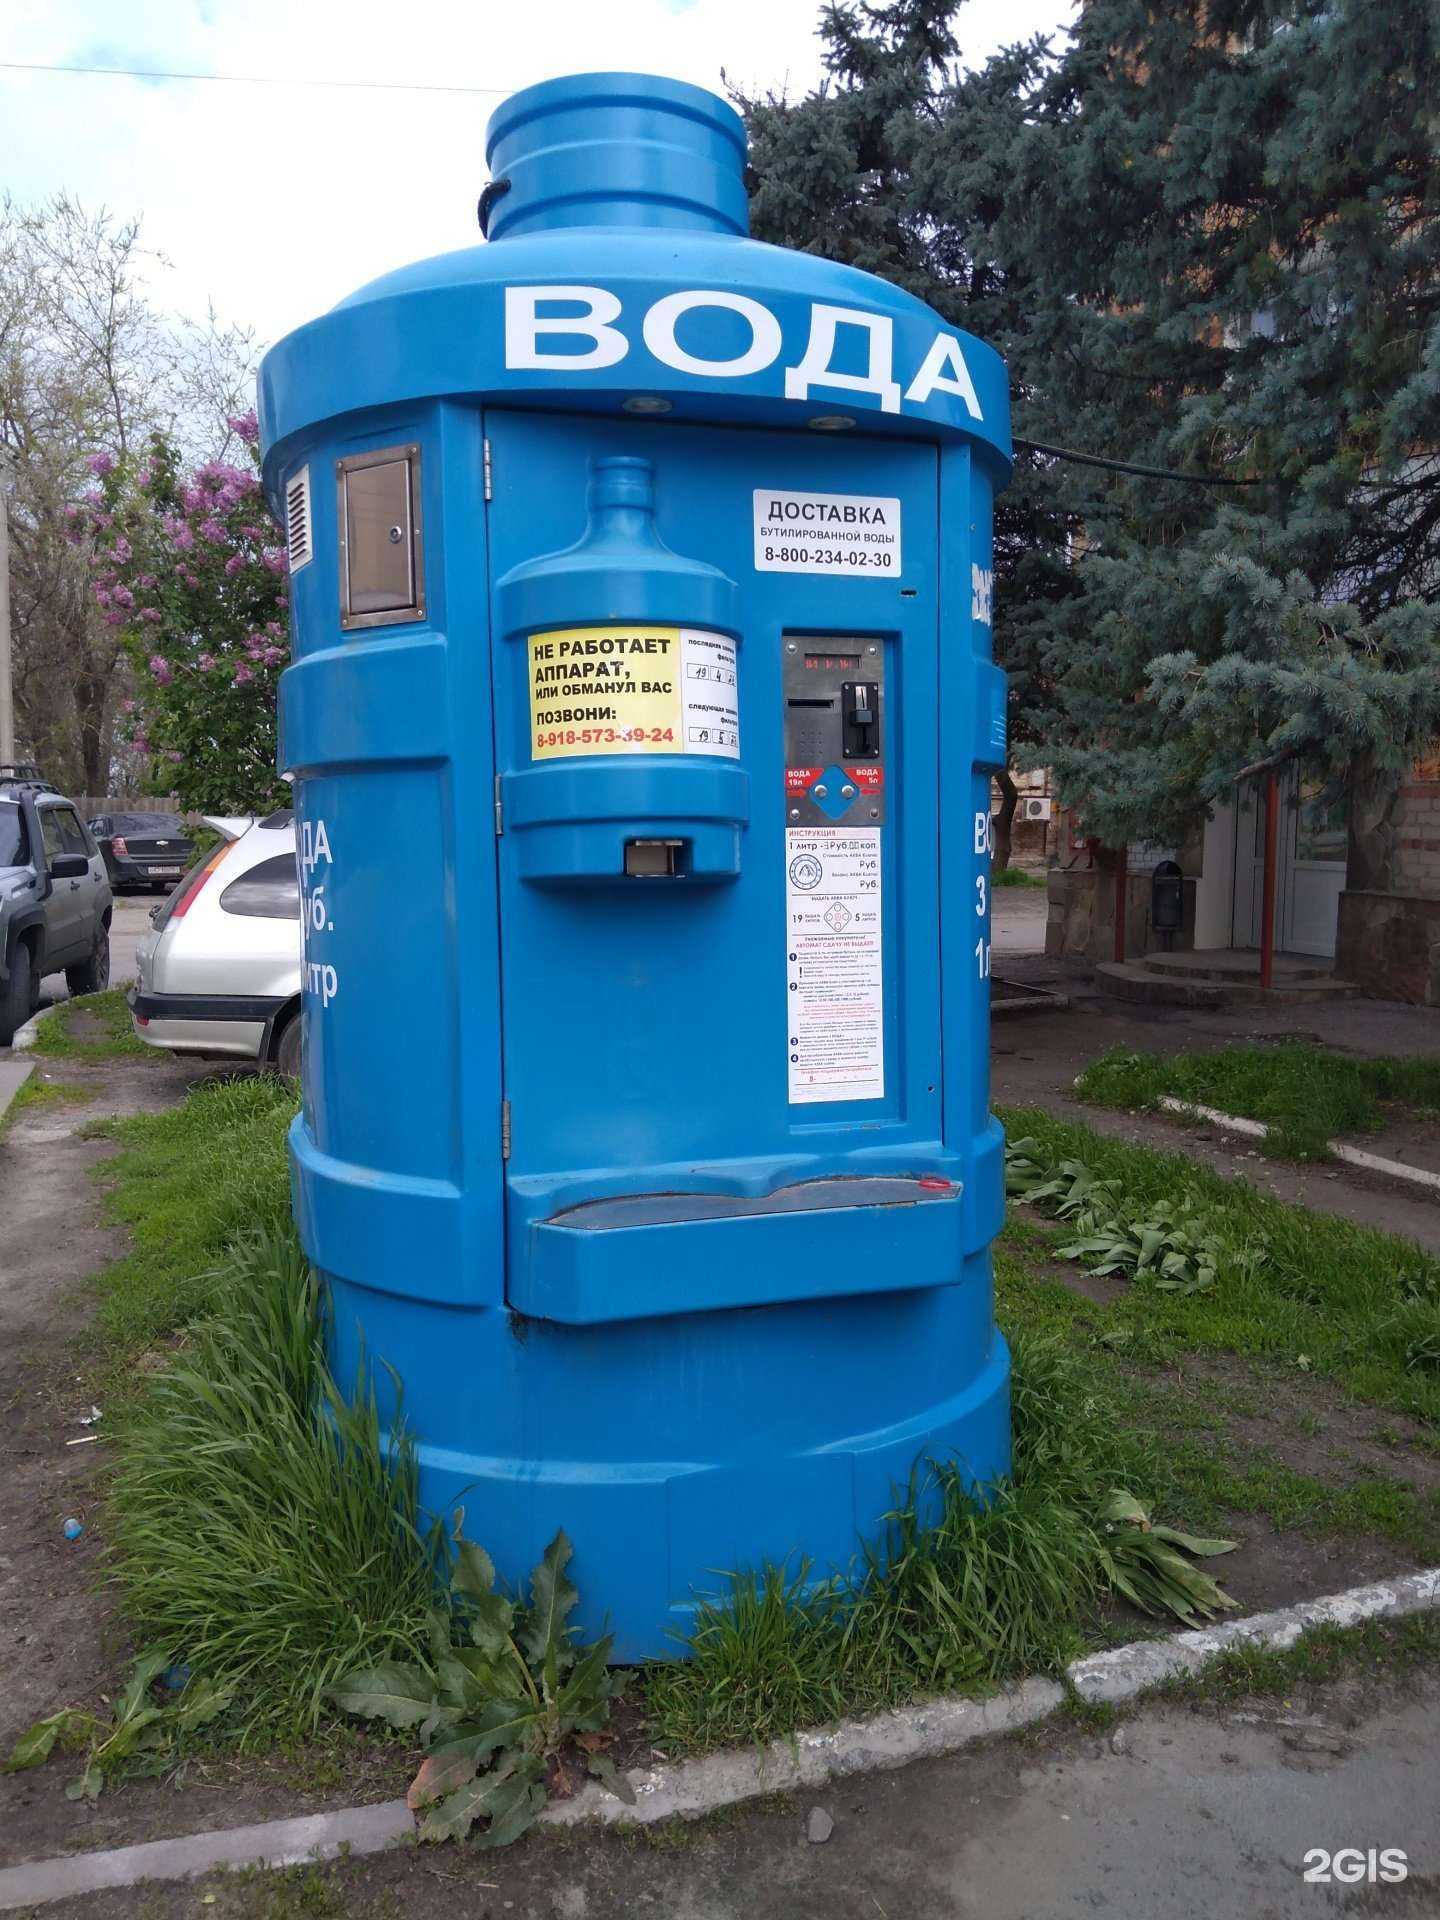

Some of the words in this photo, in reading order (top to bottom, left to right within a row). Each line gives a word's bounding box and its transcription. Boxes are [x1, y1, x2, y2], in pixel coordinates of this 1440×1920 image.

[504, 285, 985, 422] ВОДА
[768, 501, 886, 525] ДОСТАВКА
[760, 527, 861, 542] БУТИЛИРОВАННОЙ
[864, 533, 895, 545] ВОДЫ
[765, 546, 892, 567] 8-800-234-02-30
[534, 643, 554, 661] НЕ
[559, 638, 671, 657] РАБОТАЕТ
[535, 660, 631, 684] АППАРАТ,
[536, 685, 559, 700] ИЛИ
[562, 681, 636, 697] ОБМАНУЛ
[641, 682, 673, 694] ВАС
[536, 706, 617, 726] ПОЗВОНИ:
[787, 770, 811, 778] ВОДА
[856, 769, 879, 777] ВОДА
[975, 875, 986, 917] 3
